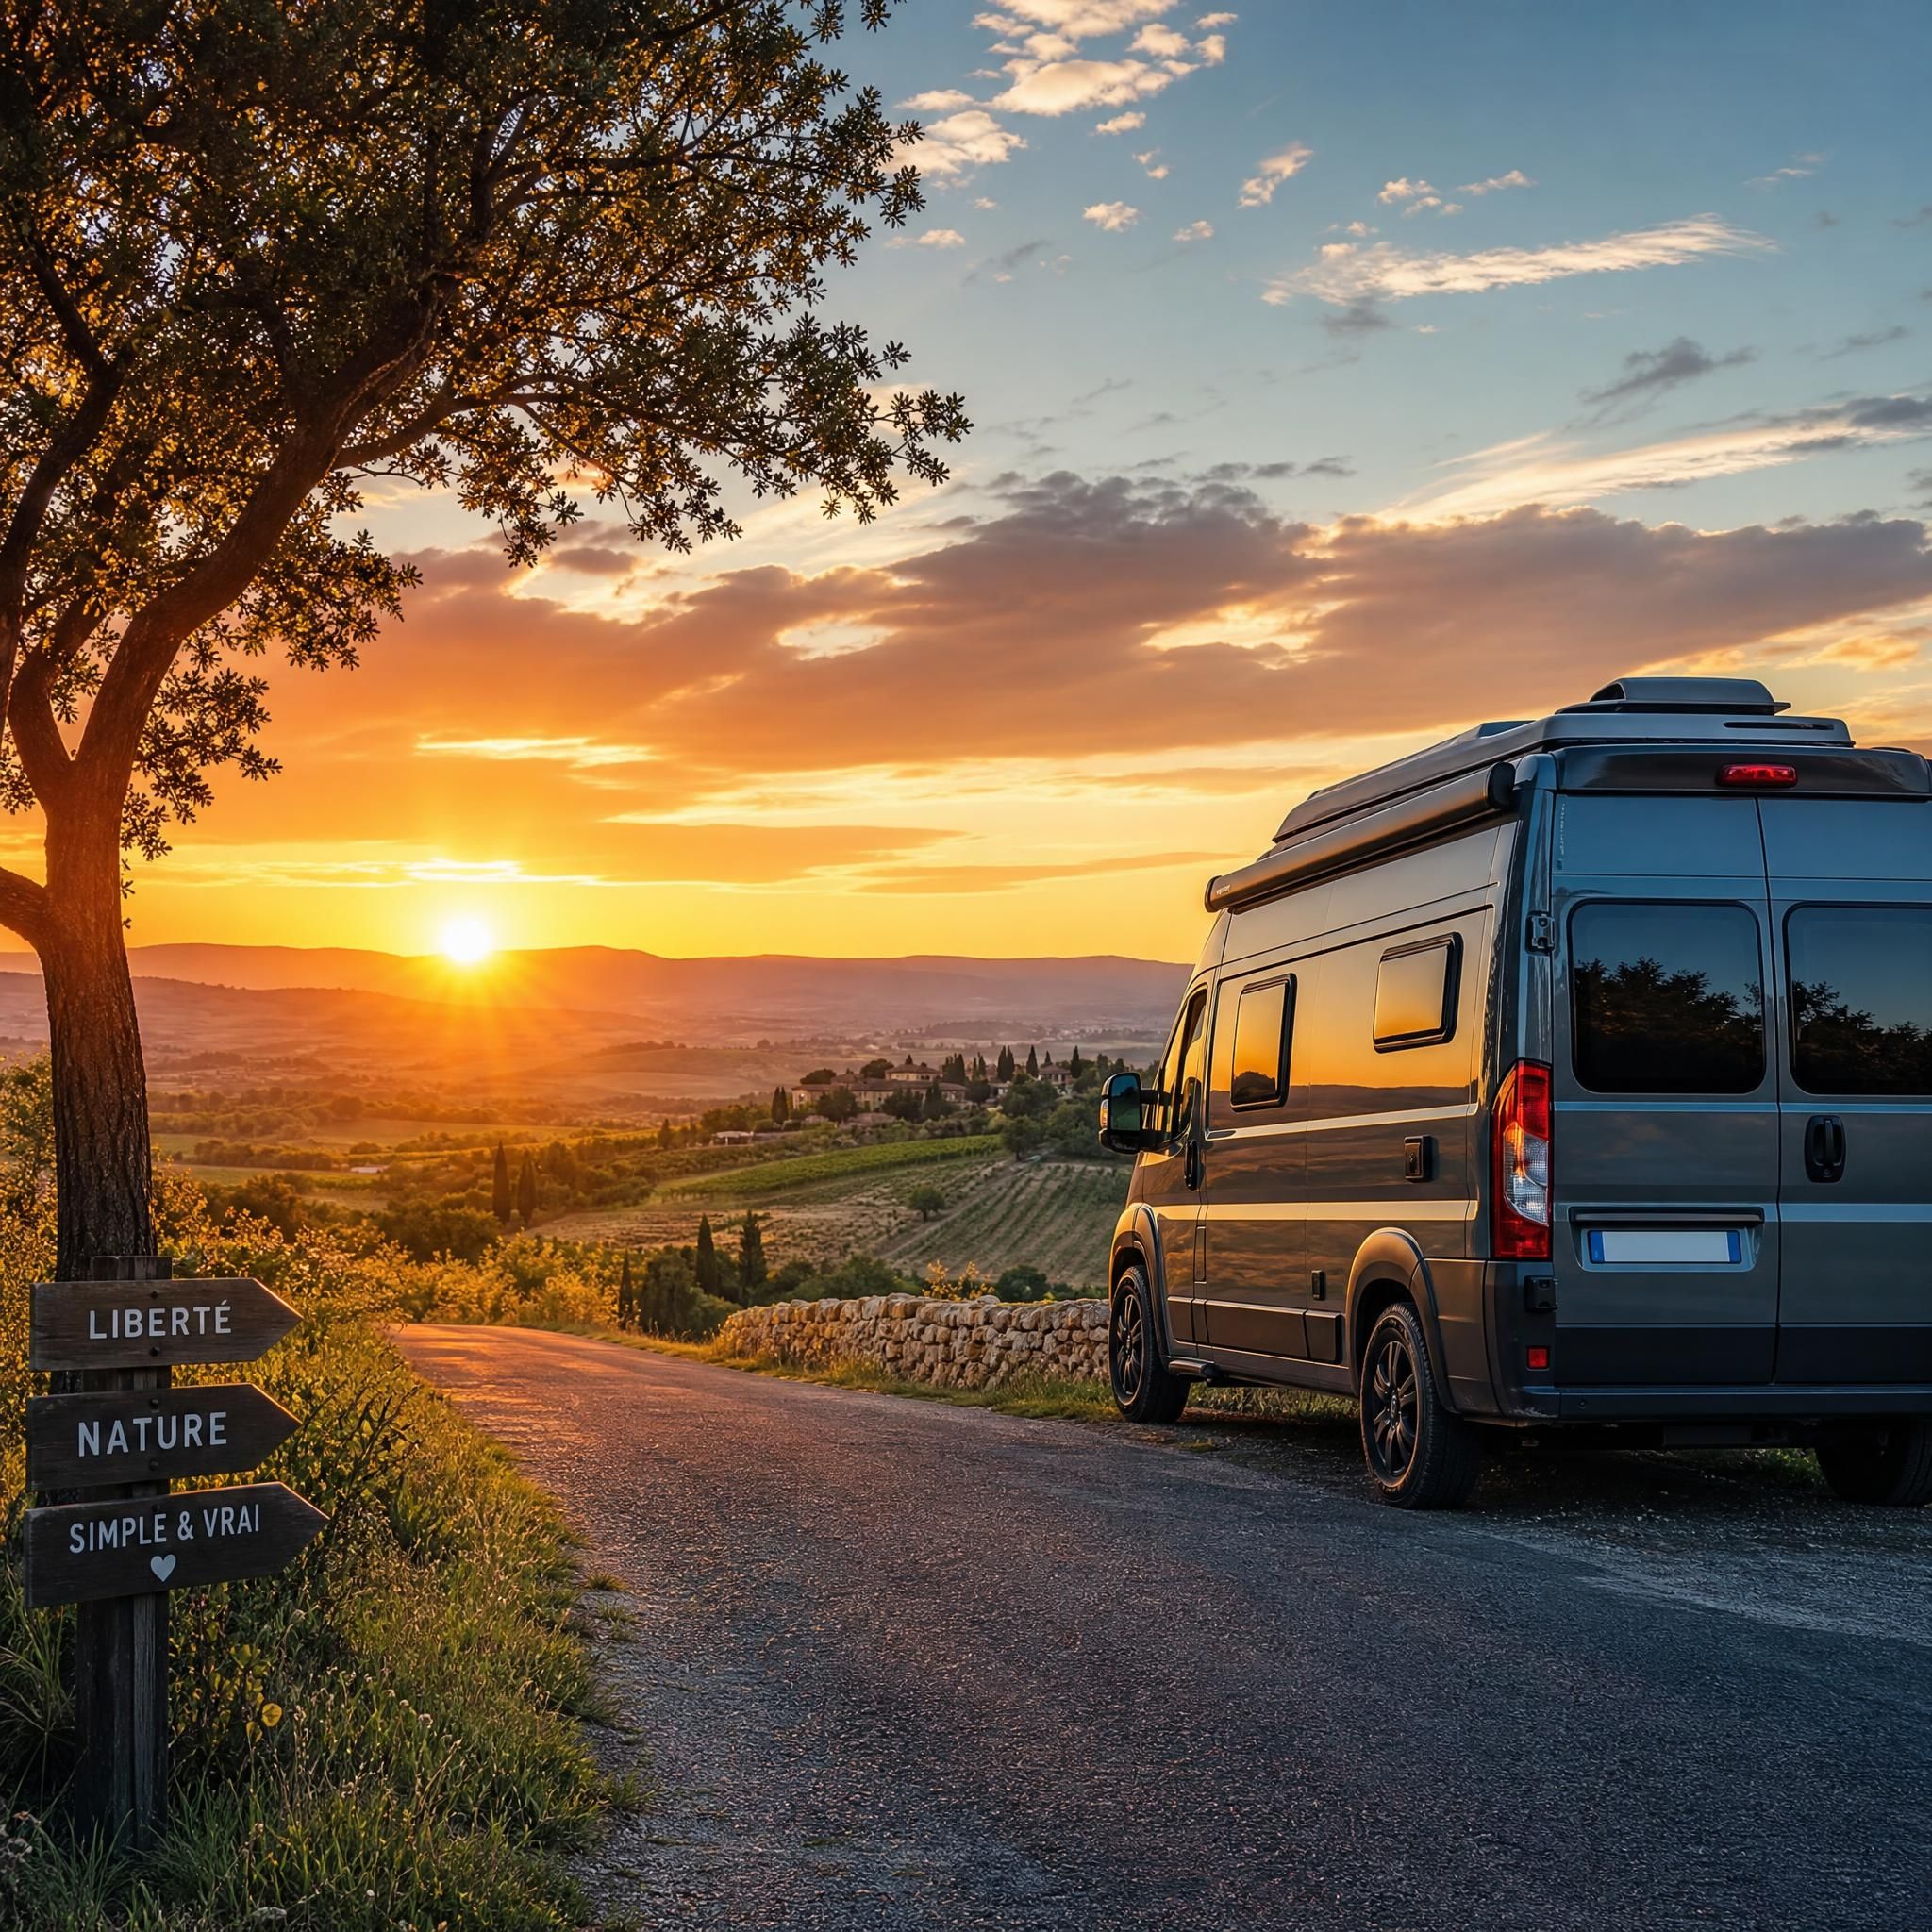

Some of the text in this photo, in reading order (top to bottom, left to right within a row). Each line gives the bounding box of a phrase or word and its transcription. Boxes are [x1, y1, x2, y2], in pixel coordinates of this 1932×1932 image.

[89, 1299, 232, 1340] LIBERTÉ
[78, 1411, 227, 1457] NATURE
[69, 1504, 260, 1554] SIMPLE & VRAI
